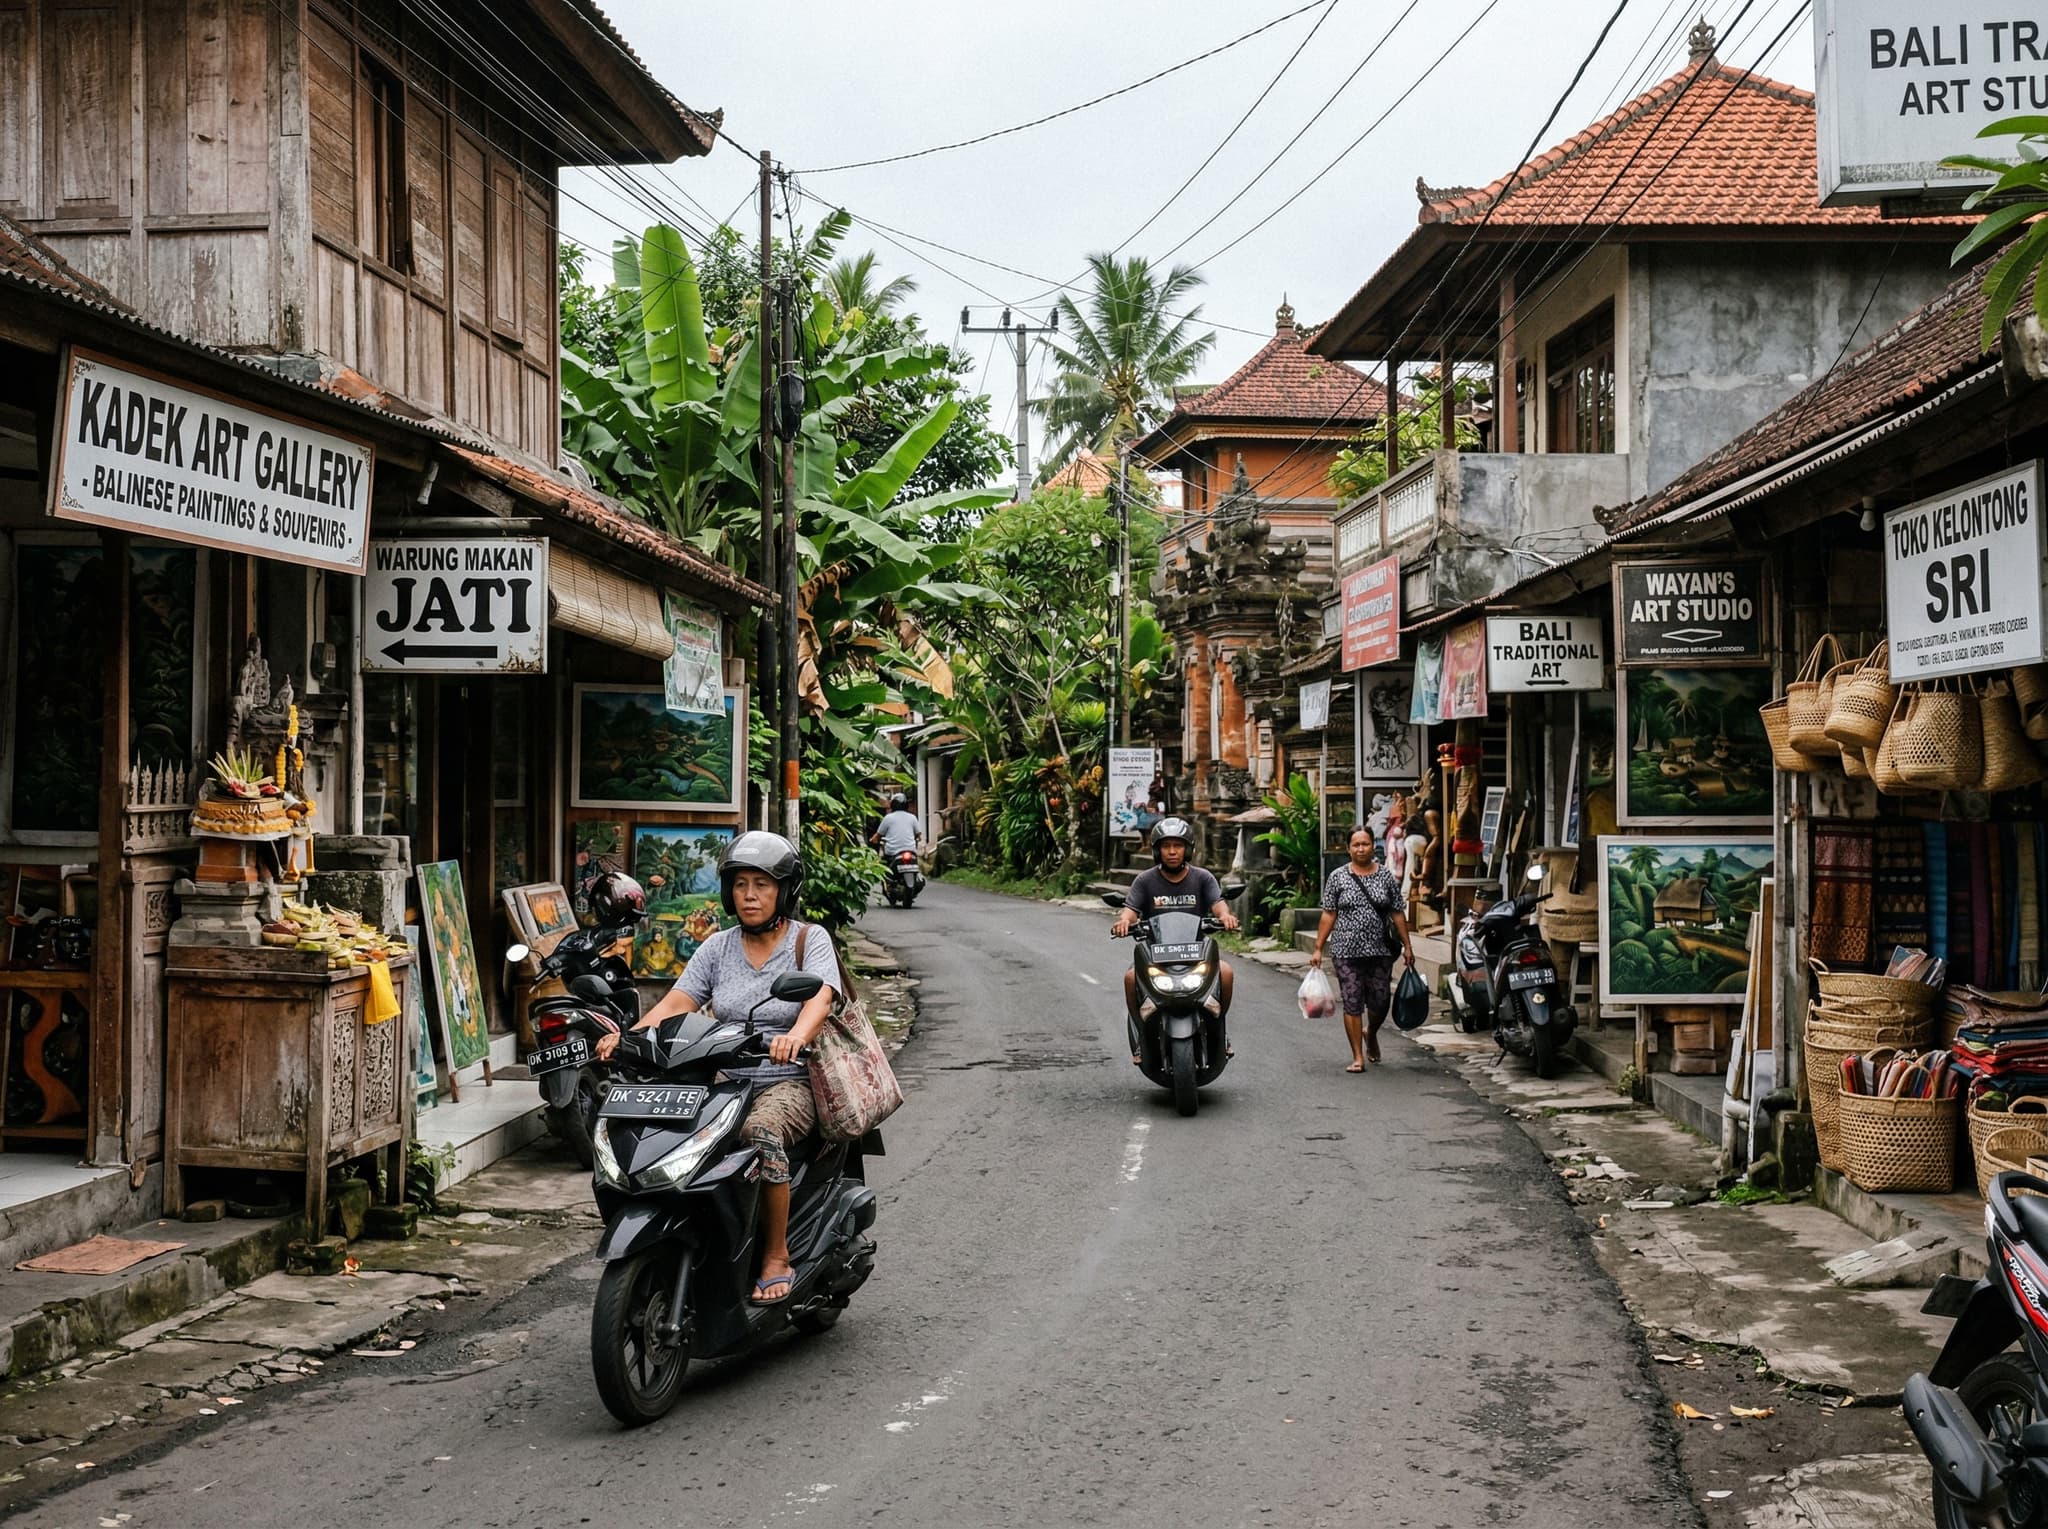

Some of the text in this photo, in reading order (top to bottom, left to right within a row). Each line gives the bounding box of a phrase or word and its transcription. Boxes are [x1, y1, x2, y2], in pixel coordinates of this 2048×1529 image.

[1870, 20, 2048, 69] BALI TR
[1899, 79, 1970, 116] ART
[79, 378, 362, 510] KADEK ART GALLERY
[92, 465, 346, 550] BALINESE PAINTINGS & SOUVENIRS
[1892, 480, 2028, 560] TOKO KELONTONG
[376, 547, 533, 571] WARUNG MAKAN
[1645, 571, 1735, 596] WAYAN'S
[1926, 548, 1991, 623] SRI
[376, 577, 532, 633] JATI
[1630, 598, 1753, 622] ART STUDIO
[1520, 621, 1572, 641] BALI
[1493, 644, 1599, 661] TRADITIONAL
[1531, 662, 1562, 678] ART
[530, 1054, 542, 1066] DK
[611, 1090, 632, 1102] DK
[677, 1091, 698, 1104] FE
